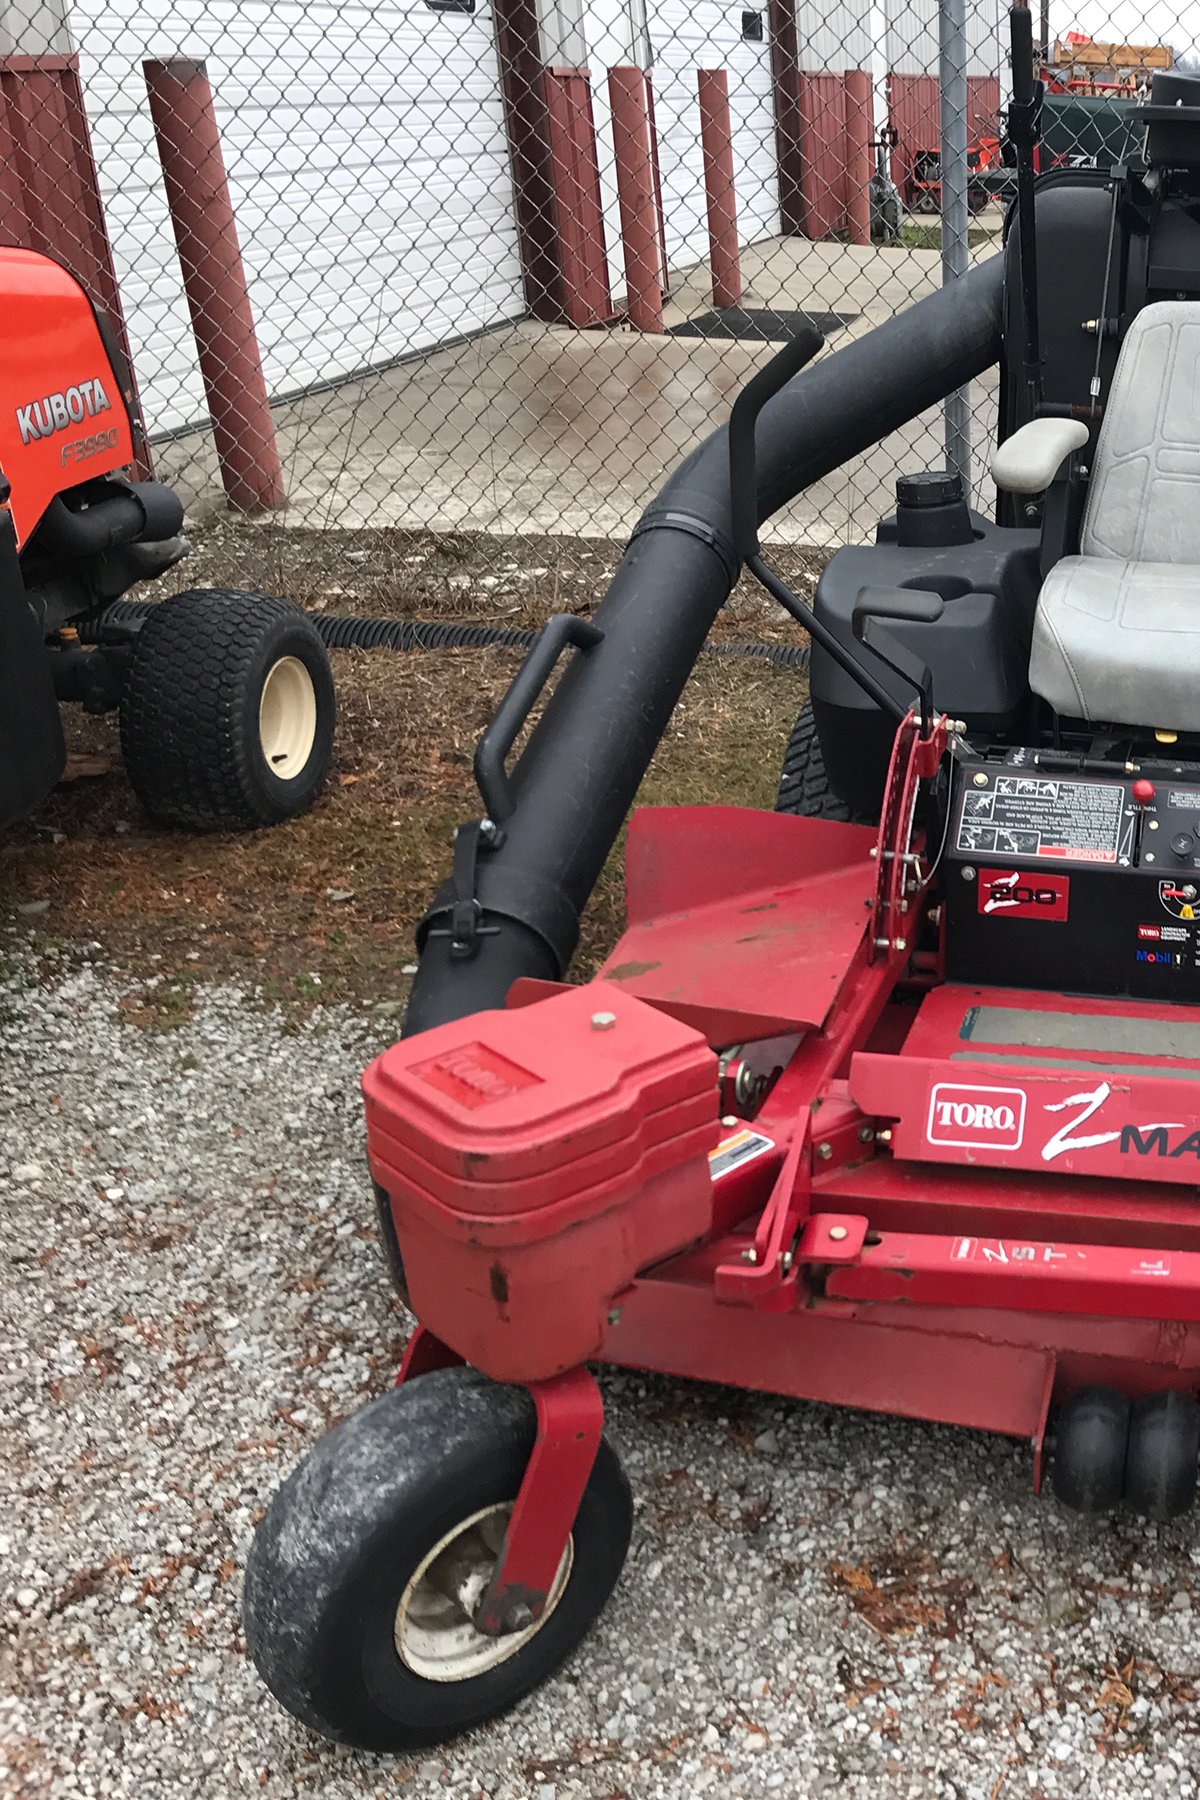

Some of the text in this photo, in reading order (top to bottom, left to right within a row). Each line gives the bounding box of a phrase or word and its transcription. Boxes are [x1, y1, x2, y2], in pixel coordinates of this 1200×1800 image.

[16, 377, 111, 445] KUBOTA
[61, 427, 118, 468] F3990
[1065, 849, 1105, 860] DANGER
[1138, 927, 1159, 936] TORO
[1135, 950, 1171, 963] Mobil
[937, 1101, 1016, 1130] TORO
